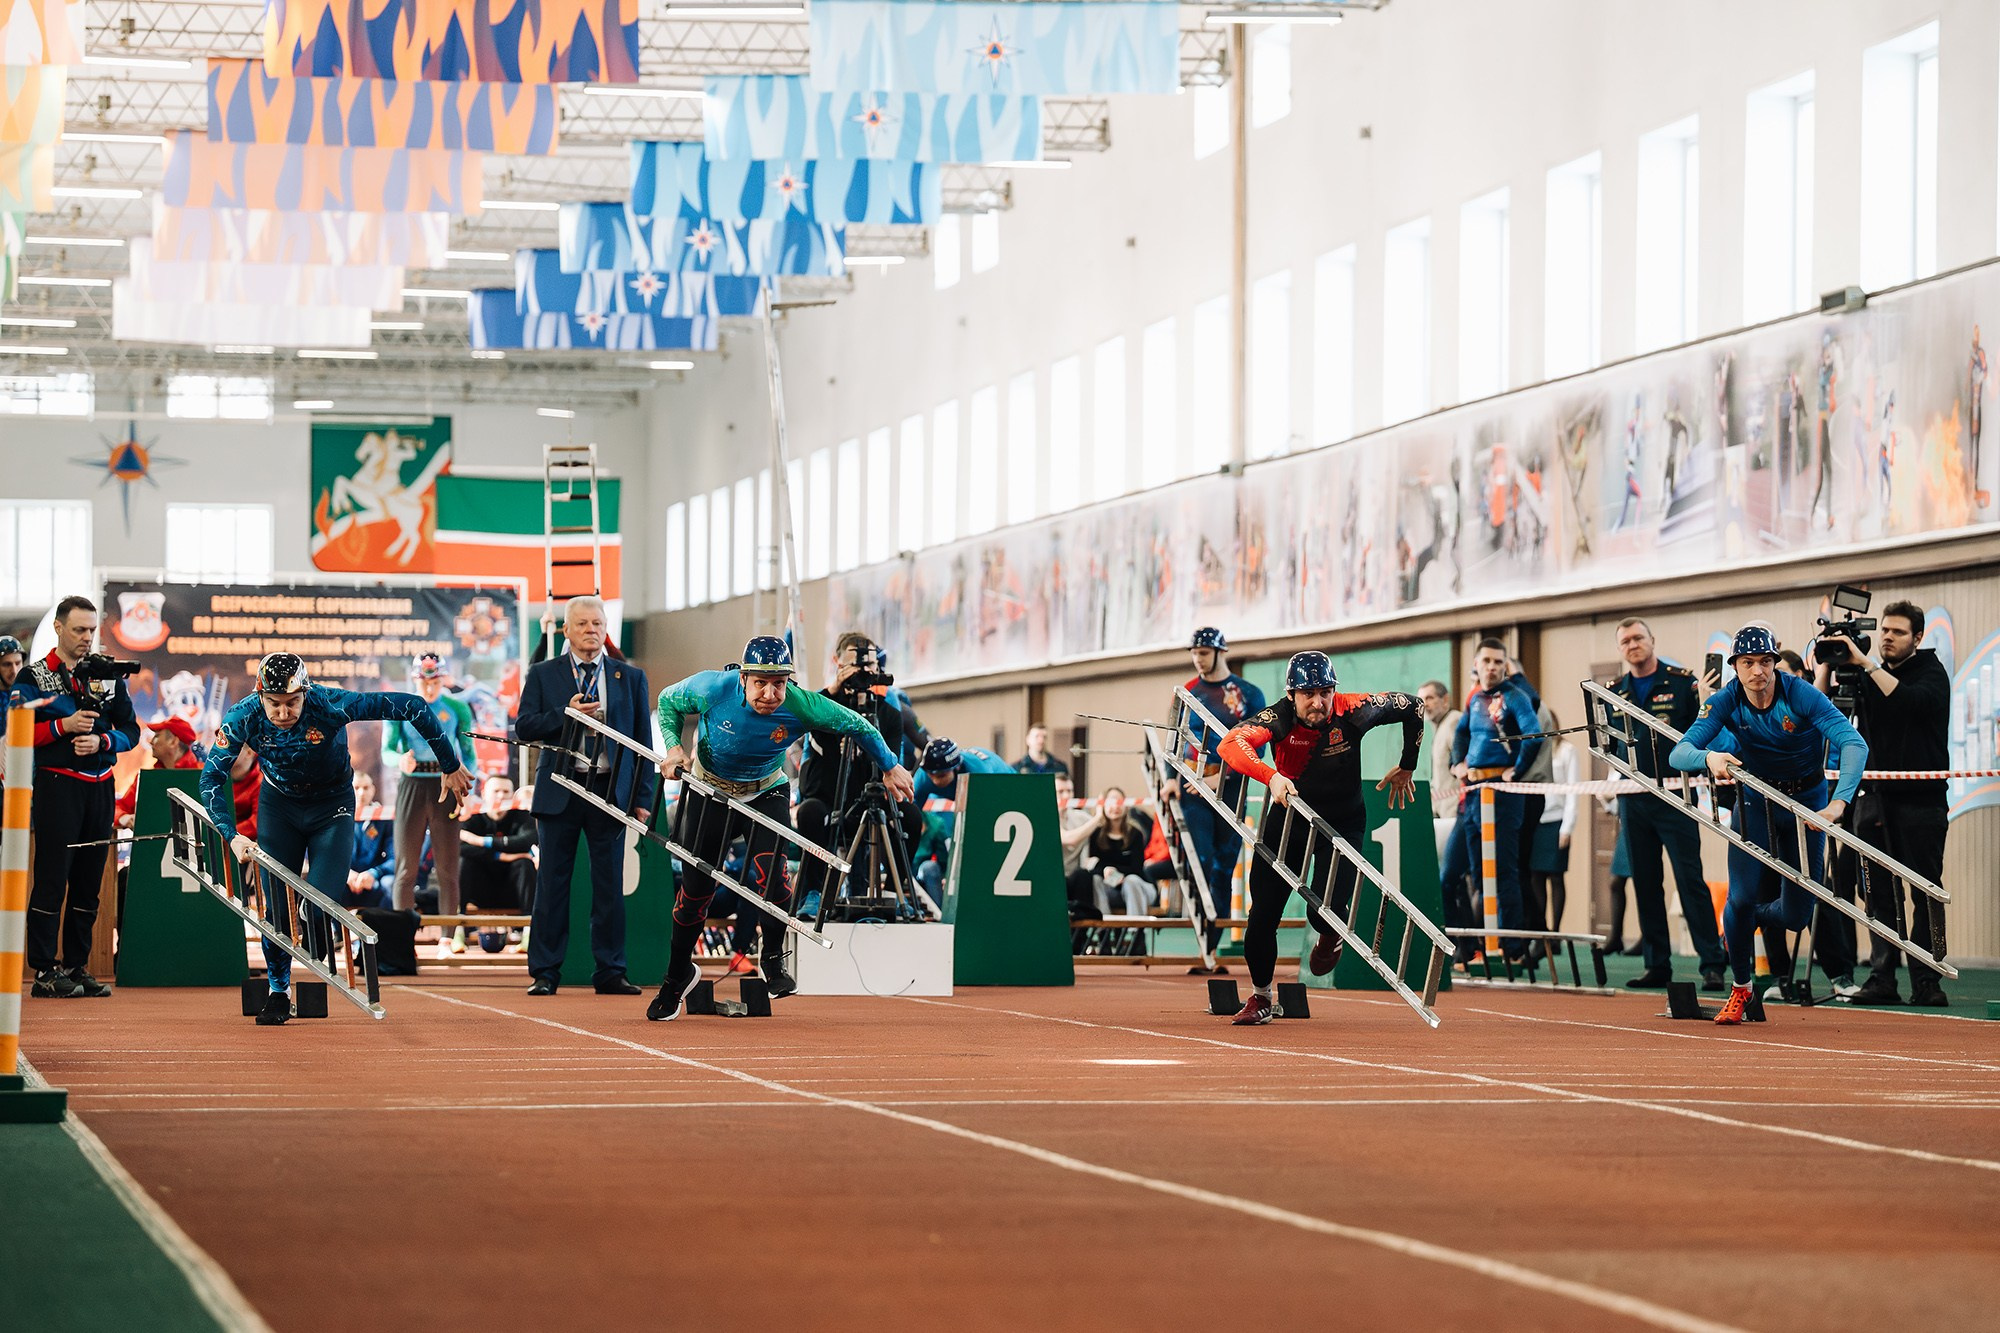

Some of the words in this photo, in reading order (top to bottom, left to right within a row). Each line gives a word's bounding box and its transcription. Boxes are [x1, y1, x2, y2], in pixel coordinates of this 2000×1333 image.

[161, 808, 205, 892] 4
[993, 811, 1034, 896] 2
[1371, 818, 1401, 892] 1
